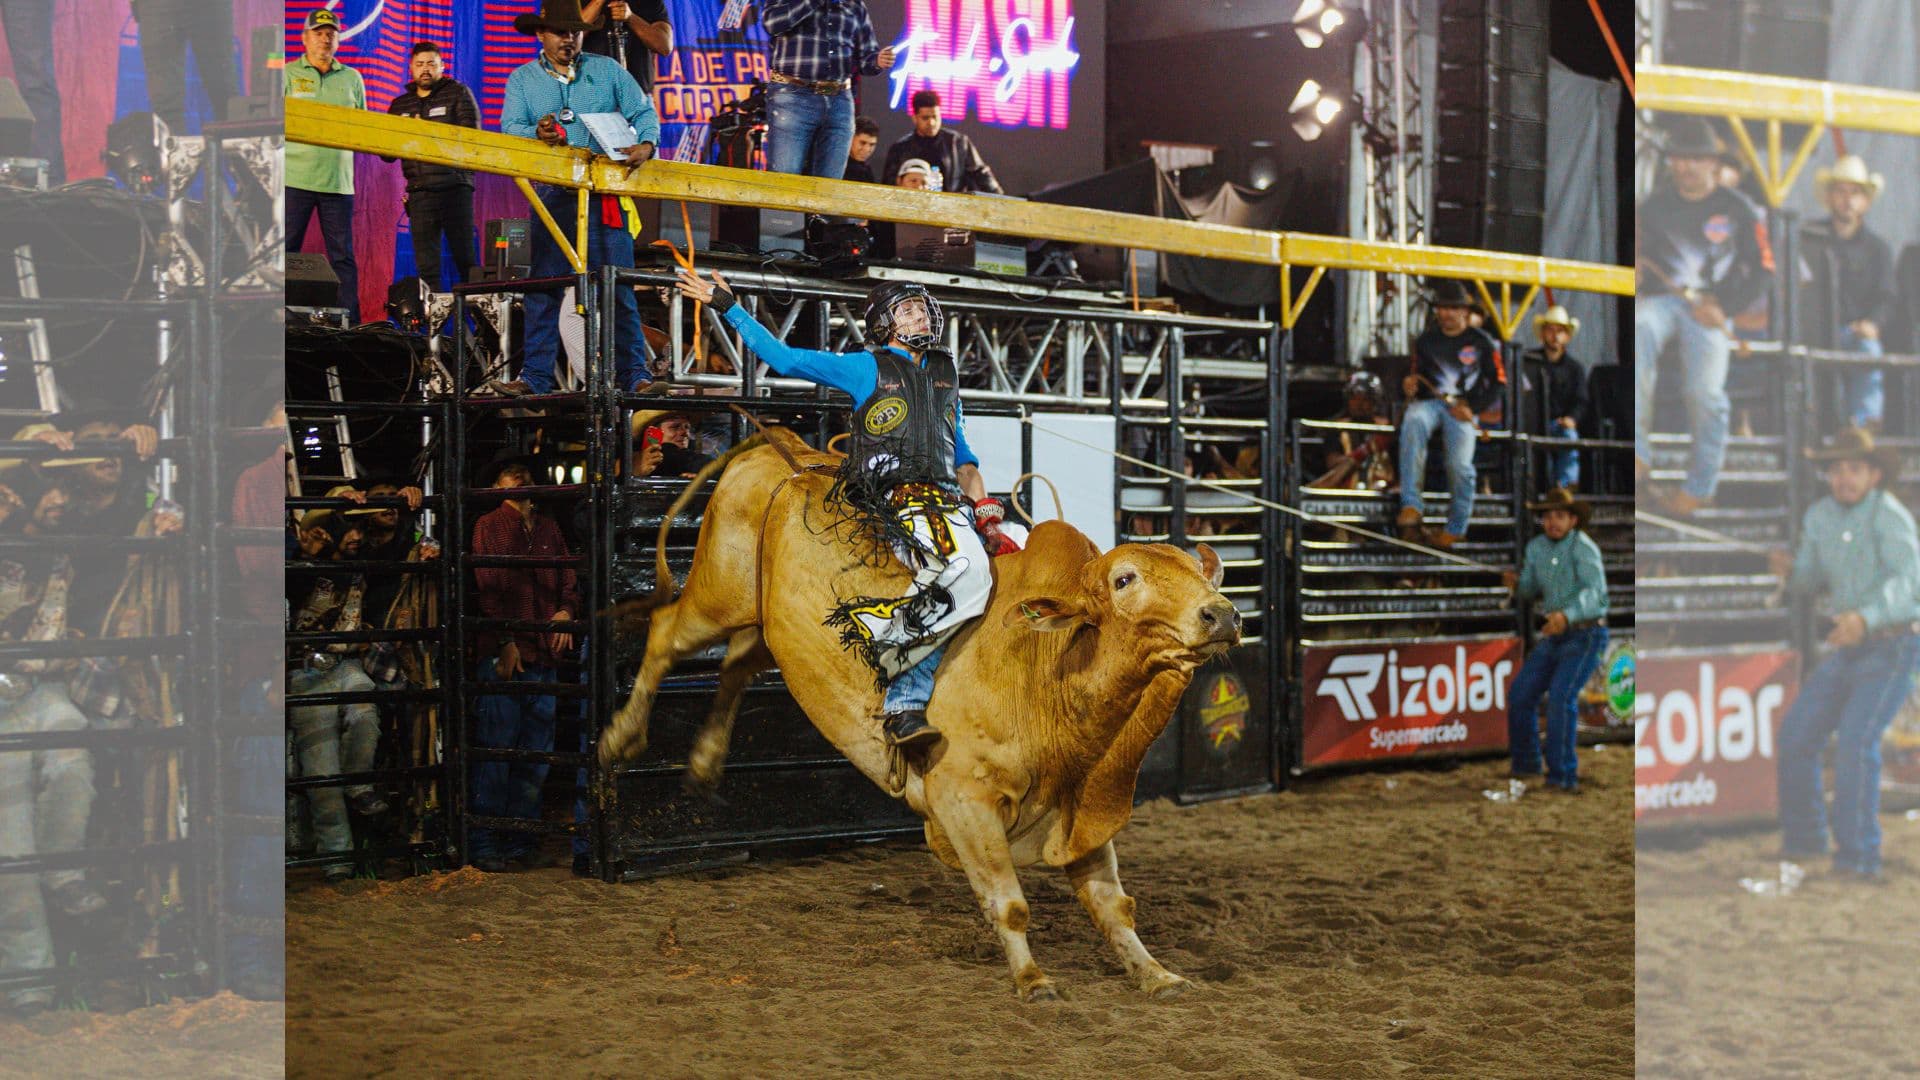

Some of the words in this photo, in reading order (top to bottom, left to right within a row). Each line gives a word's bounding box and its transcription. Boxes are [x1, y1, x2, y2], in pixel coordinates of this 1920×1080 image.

[692, 52, 727, 82] DE
[1316, 645, 1513, 721] Rizolar
[1369, 719, 1468, 751] Supermercado
